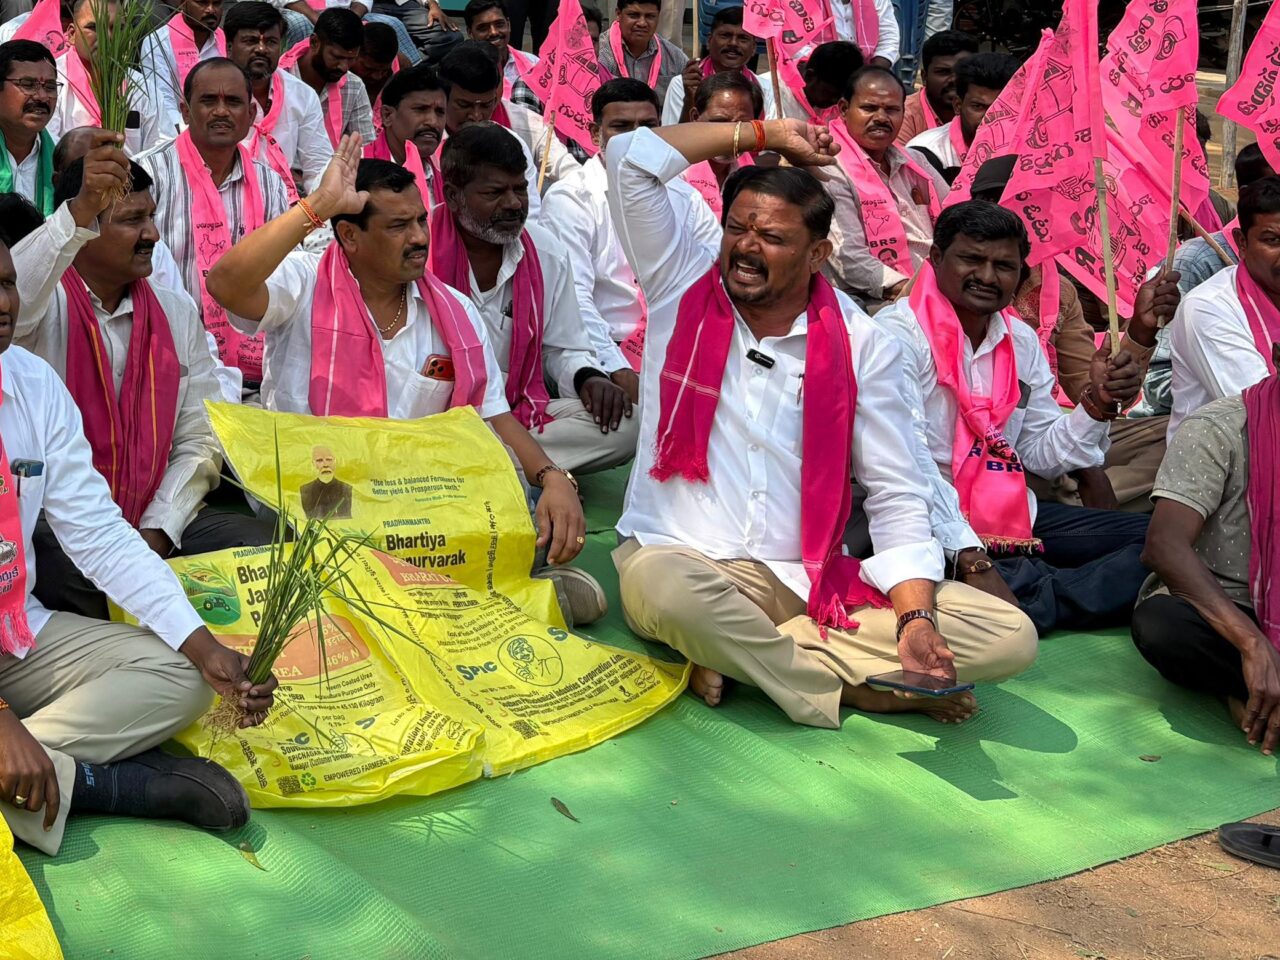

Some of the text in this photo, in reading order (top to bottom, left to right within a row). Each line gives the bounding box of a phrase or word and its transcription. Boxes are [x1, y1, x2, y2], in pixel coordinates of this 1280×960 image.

[870, 237, 897, 249] BRS
[390, 486, 404, 496] yield
[386, 532, 446, 552] Bhartiya
[359, 671, 373, 682] Urea
[456, 661, 498, 681] SPIC
[578, 661, 612, 685] Corporation
[363, 682, 376, 692] Only
[324, 759, 389, 782] EMPOWERED FARMERS,
